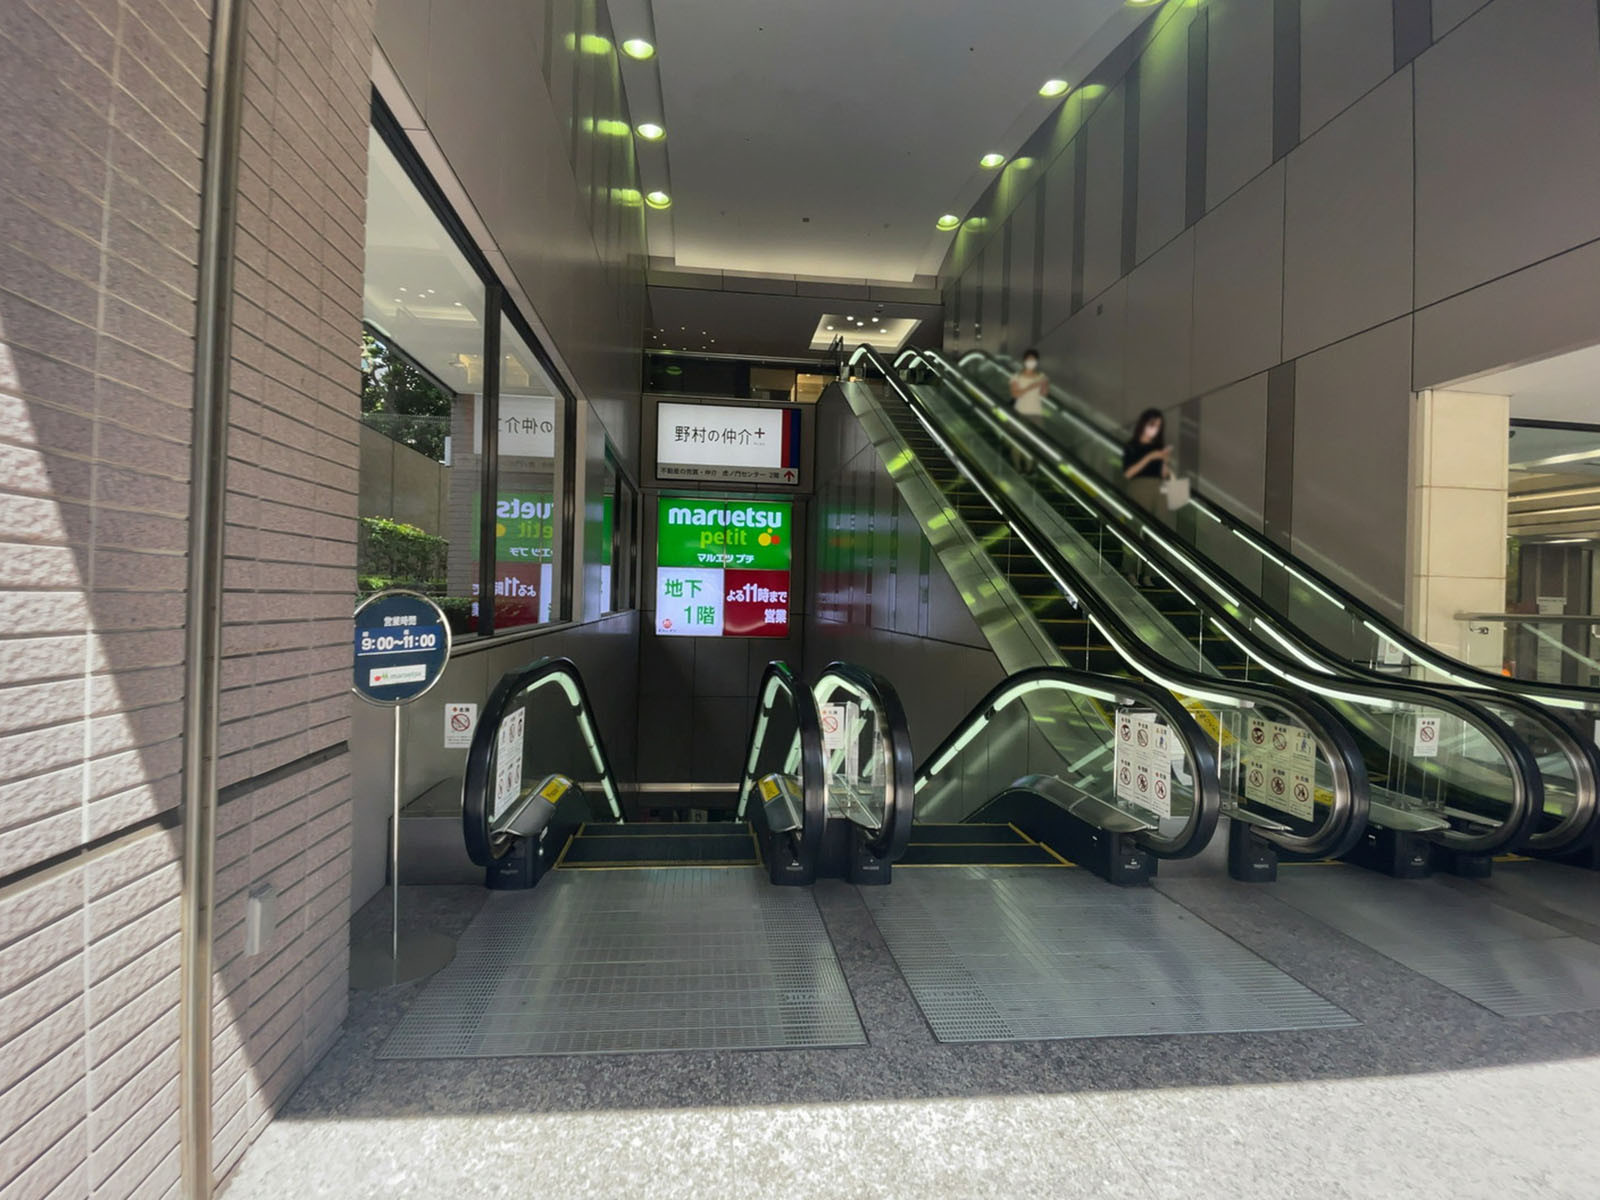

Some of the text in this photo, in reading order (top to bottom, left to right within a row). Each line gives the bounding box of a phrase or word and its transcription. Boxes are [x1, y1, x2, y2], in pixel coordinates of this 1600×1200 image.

[668, 507, 782, 528] maruetsu
[700, 528, 748, 548] petit
[697, 552, 755, 564] マルエツ プチ
[664, 578, 703, 598] 地下
[726, 583, 787, 603] よる11時まで
[384, 615, 417, 627] 営業時間
[684, 606, 715, 625] 1階
[764, 608, 787, 624] 営業
